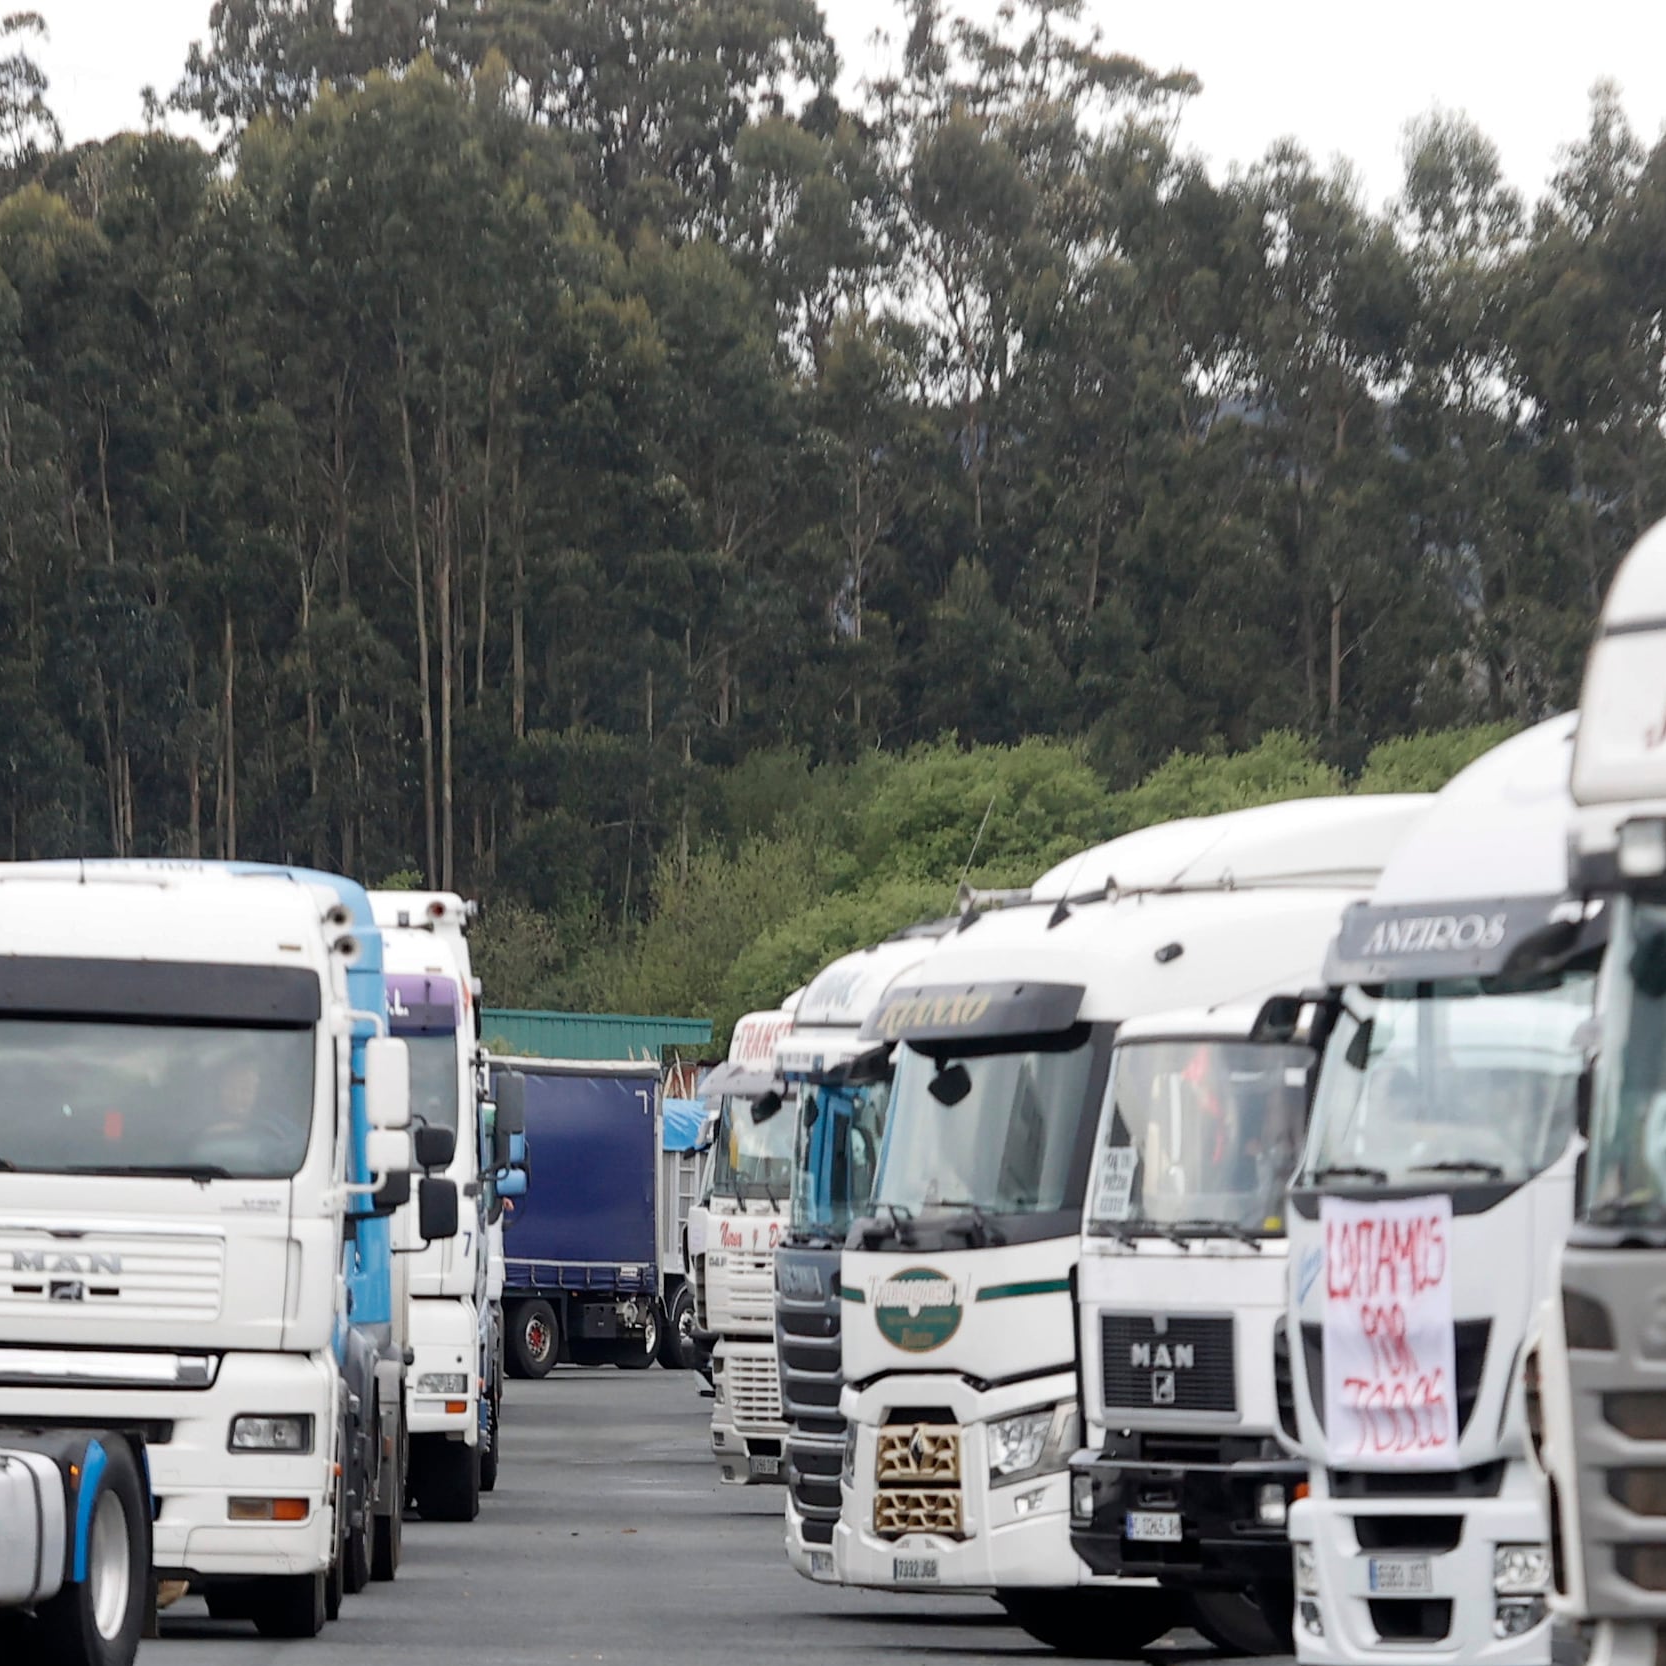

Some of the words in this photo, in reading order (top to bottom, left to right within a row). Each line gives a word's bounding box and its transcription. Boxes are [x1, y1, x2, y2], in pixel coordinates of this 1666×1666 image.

[1361, 912, 1507, 956] ANEIROS
[12, 1250, 123, 1275] MAN
[1130, 1342, 1195, 1368] MAN
